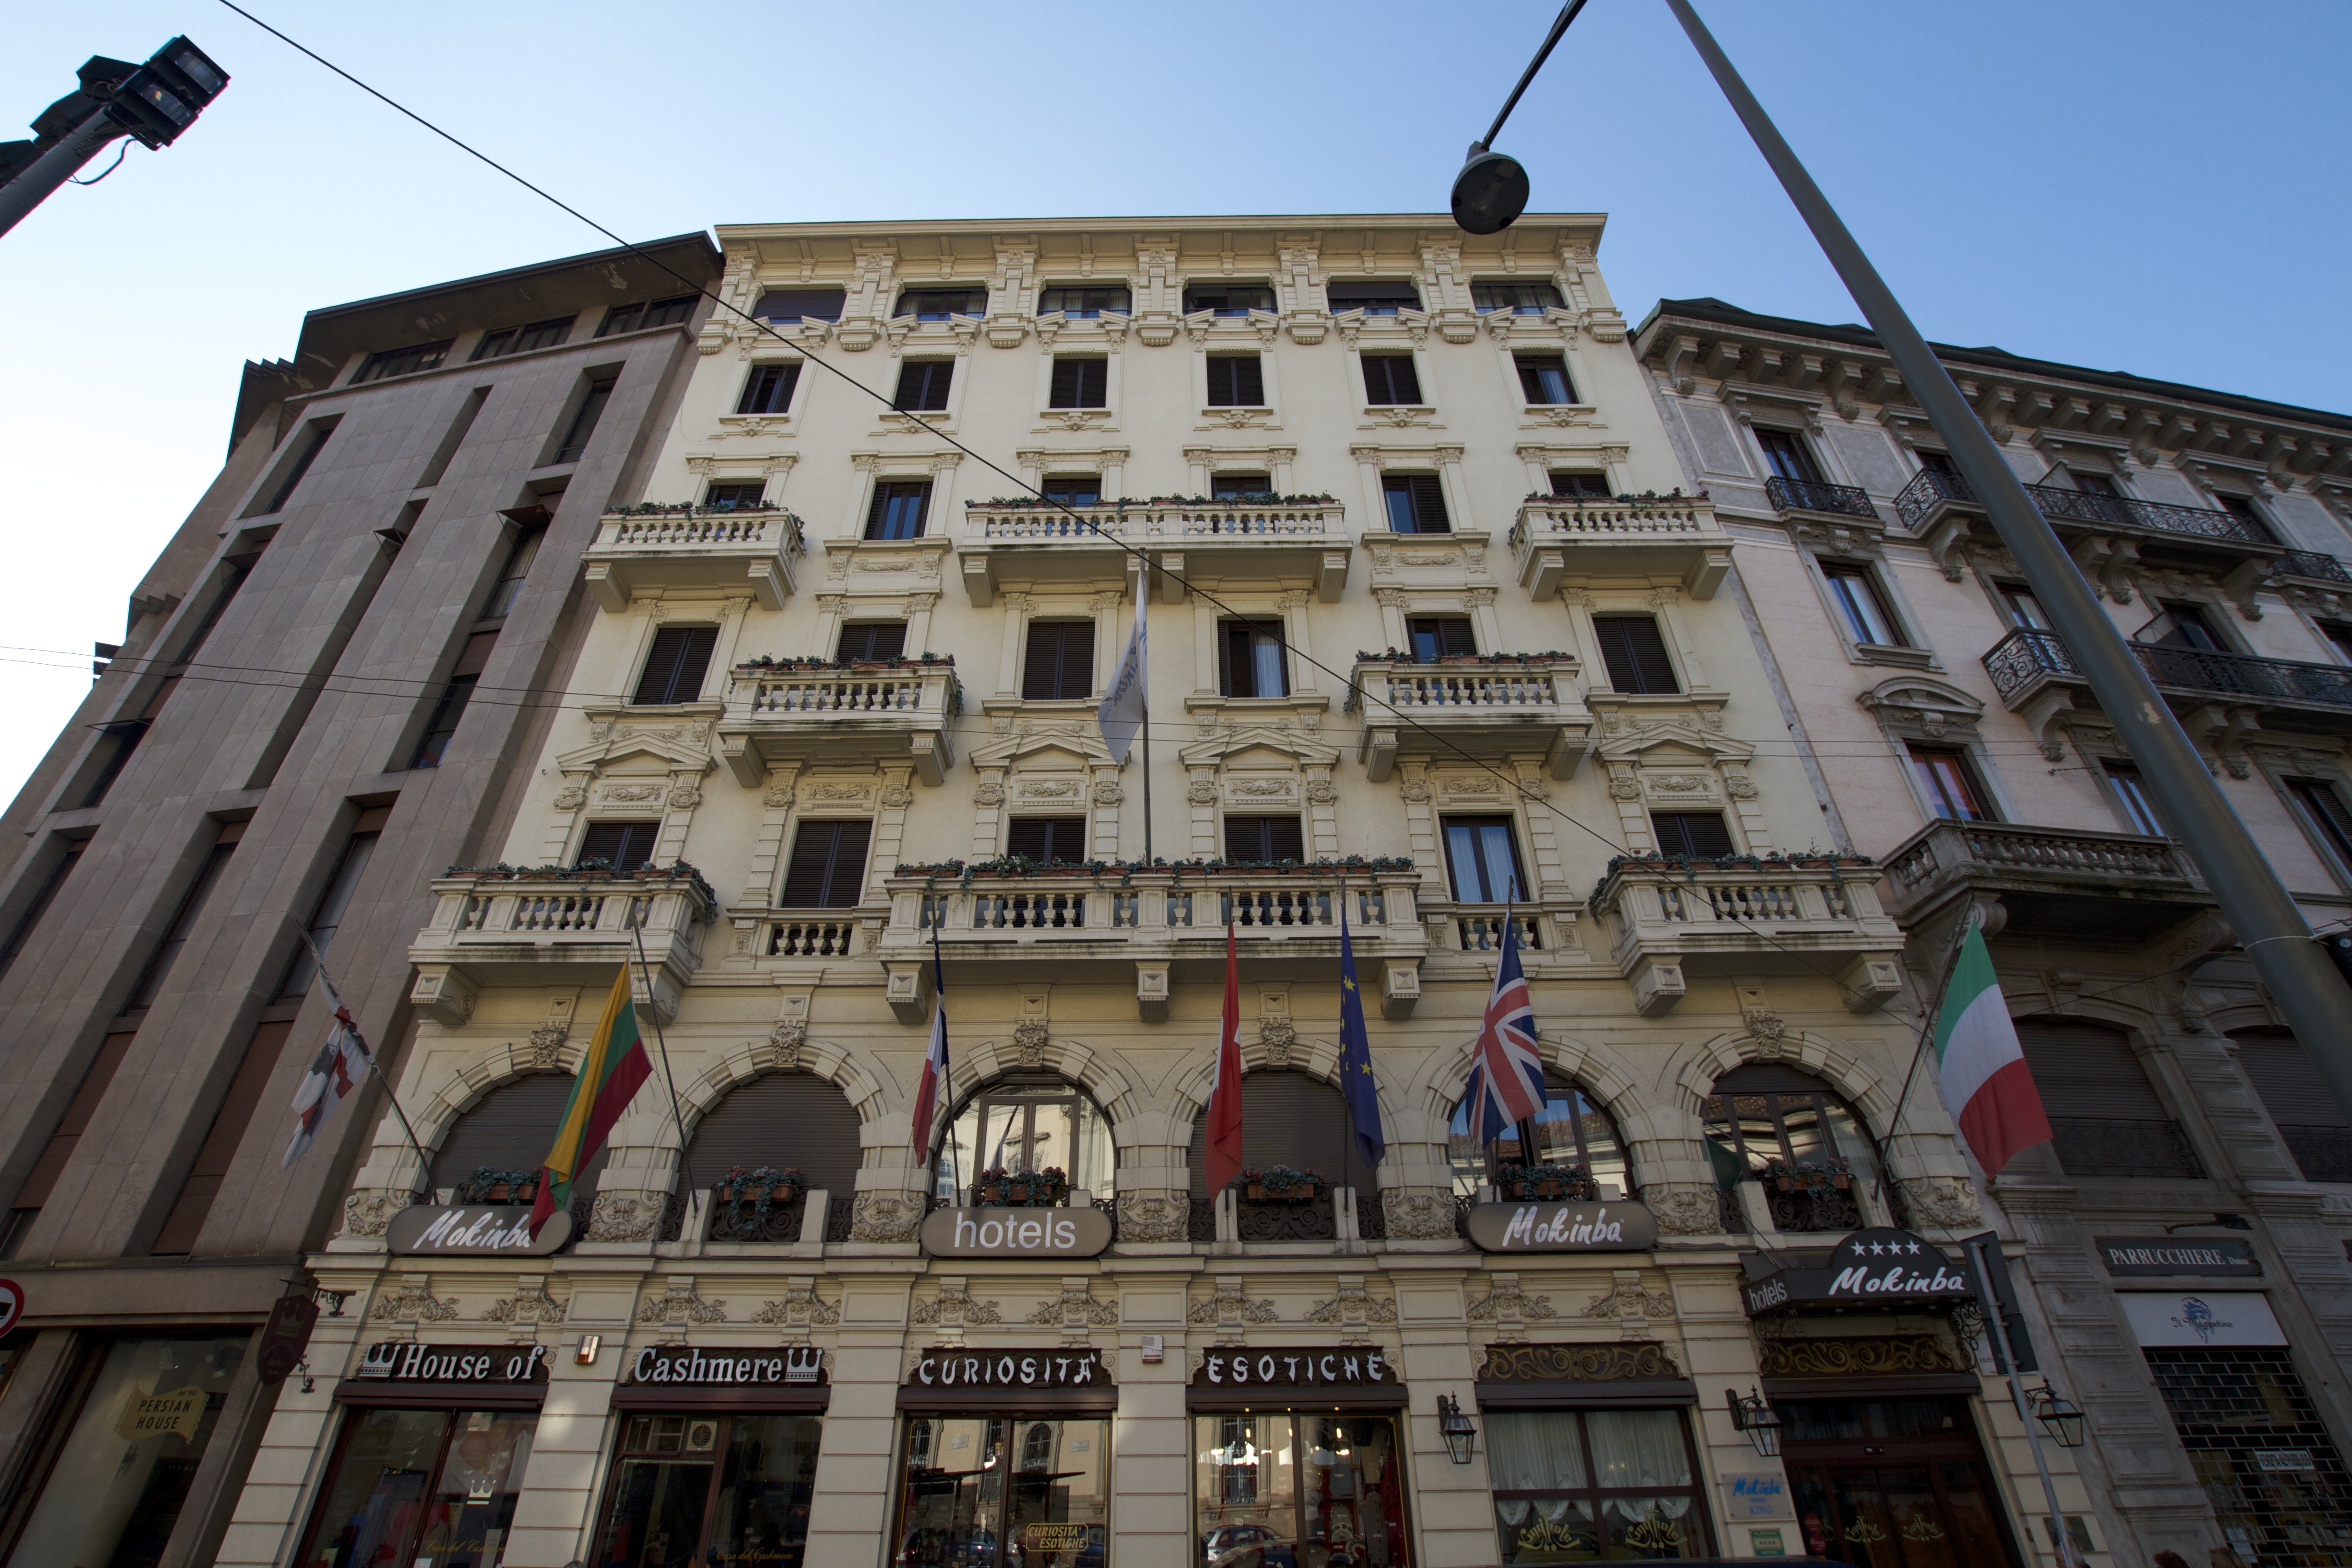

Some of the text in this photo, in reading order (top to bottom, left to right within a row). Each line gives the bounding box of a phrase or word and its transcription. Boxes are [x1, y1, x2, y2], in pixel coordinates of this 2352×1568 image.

[954, 1211, 1076, 1249] hotels
[1502, 1205, 1623, 1247] Mokinba
[2108, 1248, 2249, 1265] PARRUCCHIERE Donna
[1829, 1266, 1965, 1296] Mokinba
[1749, 1279, 1788, 1310] hotels
[397, 1344, 544, 1380] House of
[634, 1348, 782, 1382] Cashmere
[1207, 1352, 1384, 1383] ESOTICHE
[138, 1399, 192, 1412] PERSIAN
[136, 1416, 180, 1429] HOUSE
[1733, 1478, 1781, 1496] Mokinba
[448, 1541, 467, 1552] del
[738, 1549, 754, 1560] del
[754, 1547, 794, 1561] Cashmere
[1039, 1538, 1085, 1548] ESOTICHE
